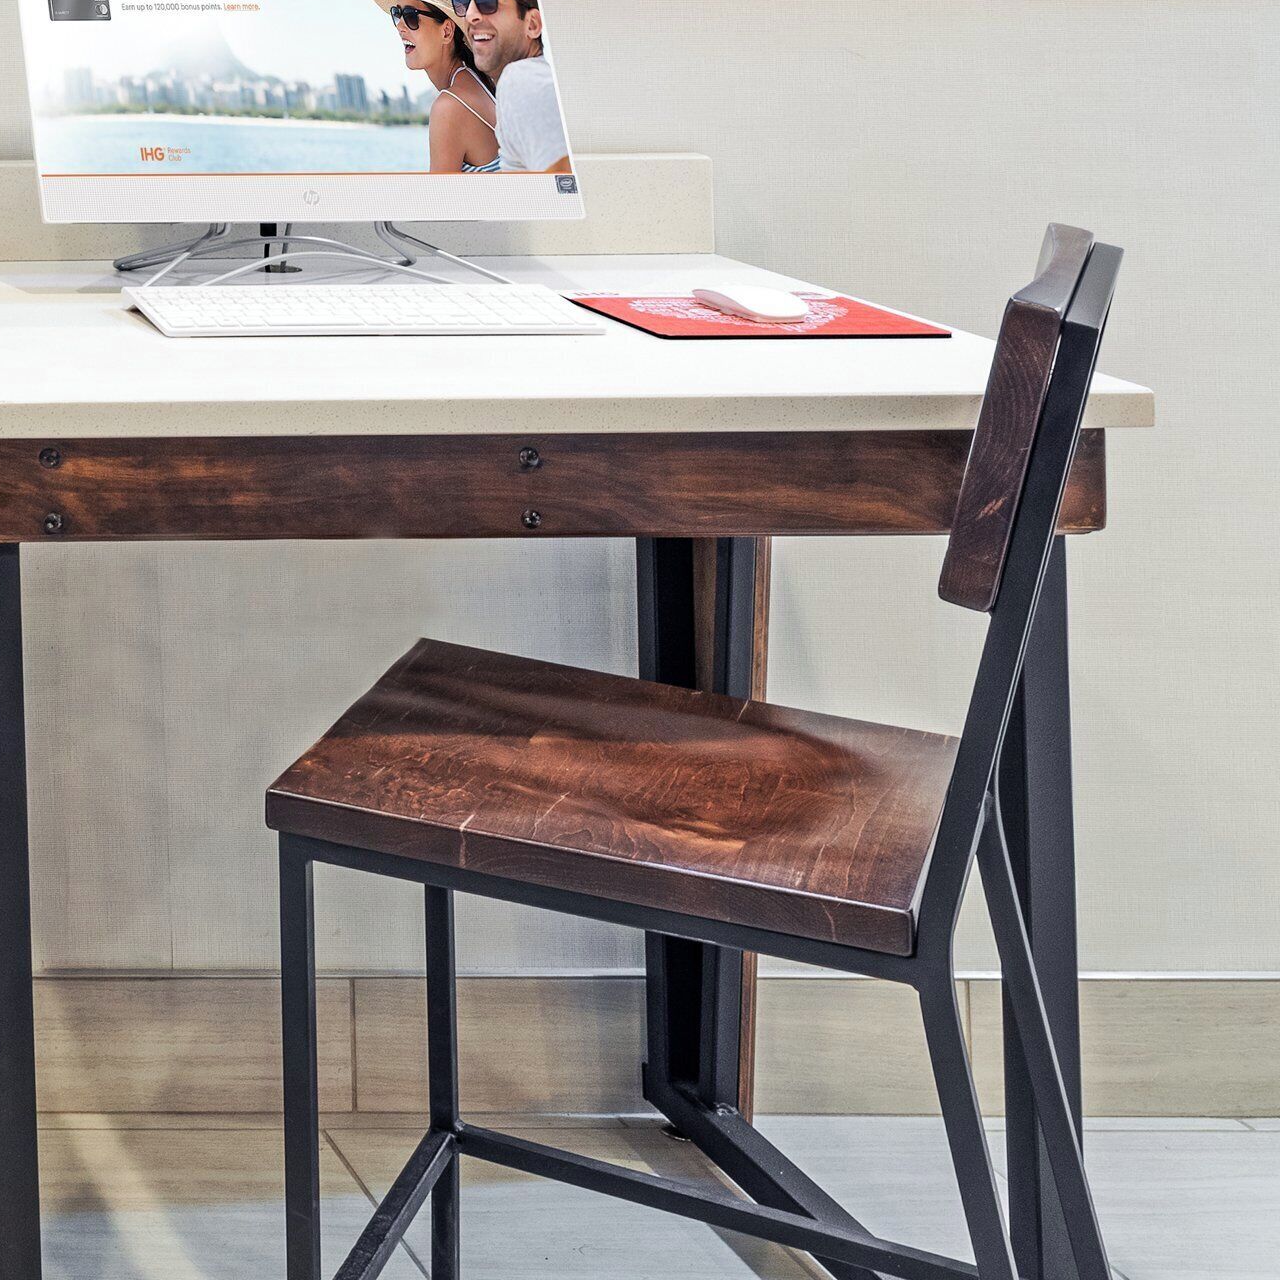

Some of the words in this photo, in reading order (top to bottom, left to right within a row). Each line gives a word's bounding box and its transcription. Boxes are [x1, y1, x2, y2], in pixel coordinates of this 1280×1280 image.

[154, 3, 180, 11] 120,000
[181, 3, 200, 11] bonus
[201, 3, 222, 11] points.
[140, 147, 164, 161] IHG
